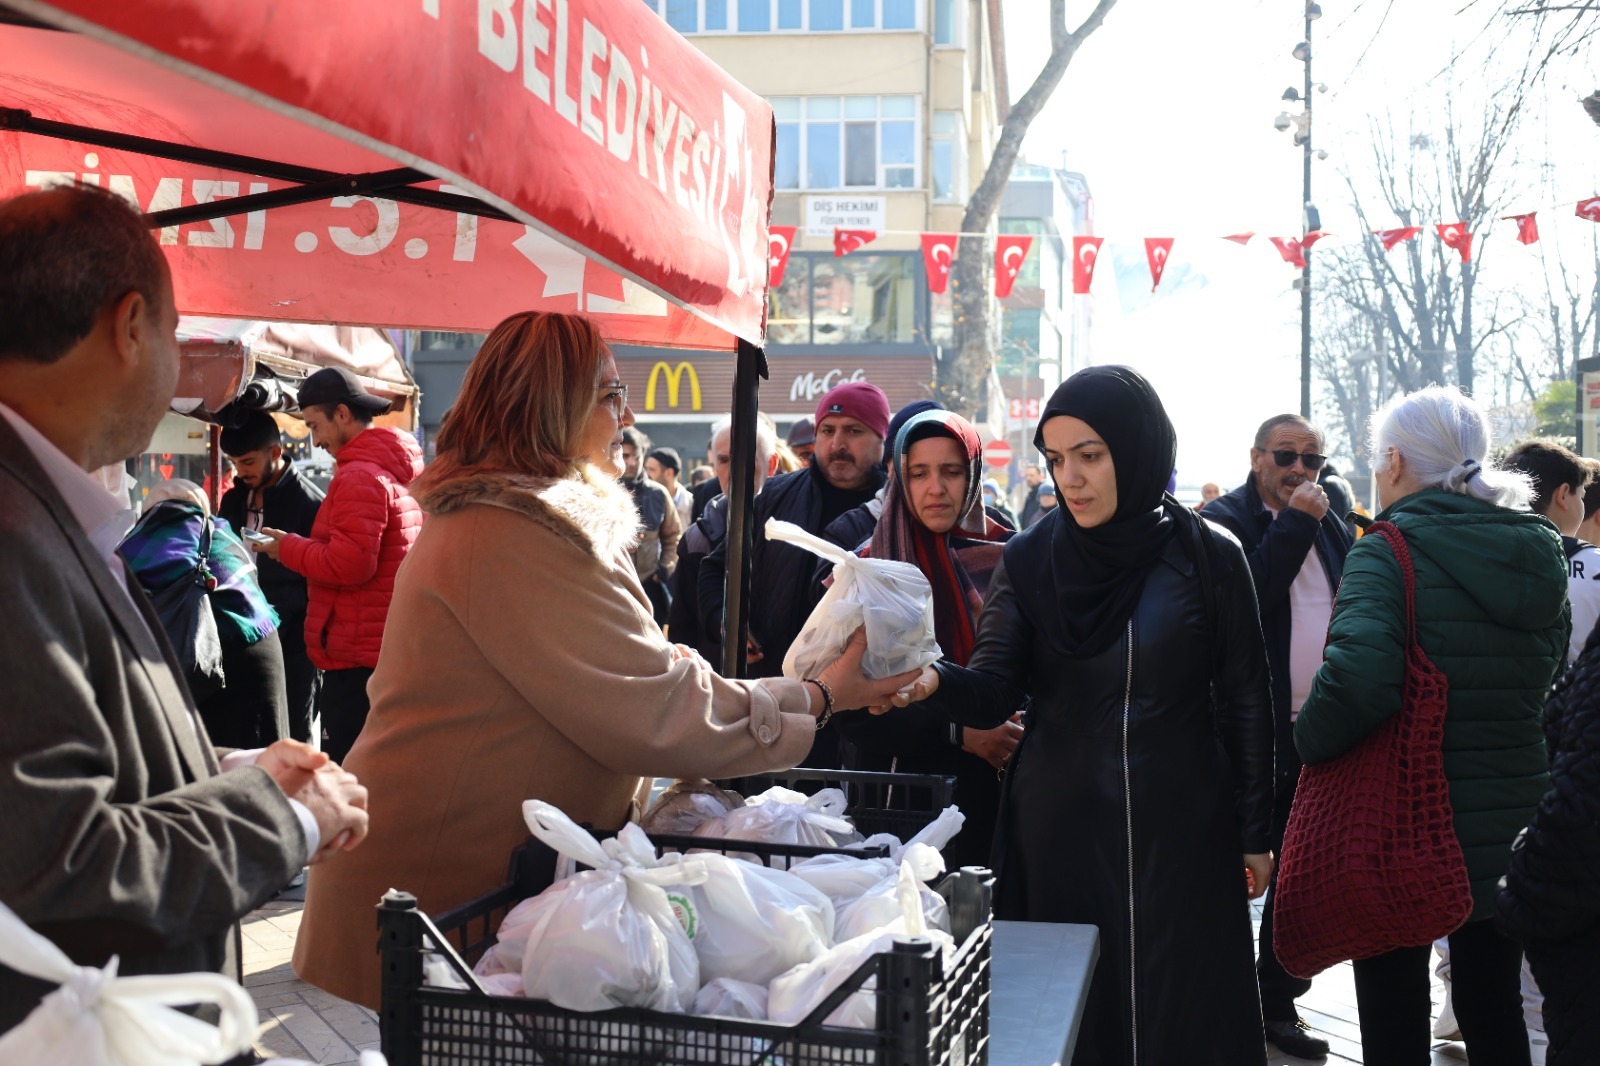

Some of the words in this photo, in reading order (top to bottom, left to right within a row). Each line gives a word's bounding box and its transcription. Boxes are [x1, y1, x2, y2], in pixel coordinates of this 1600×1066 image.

[477, 0, 721, 231] BELEDİYESİ
[813, 200, 833, 213] DİŞ
[836, 199, 879, 212] HEKİMİ
